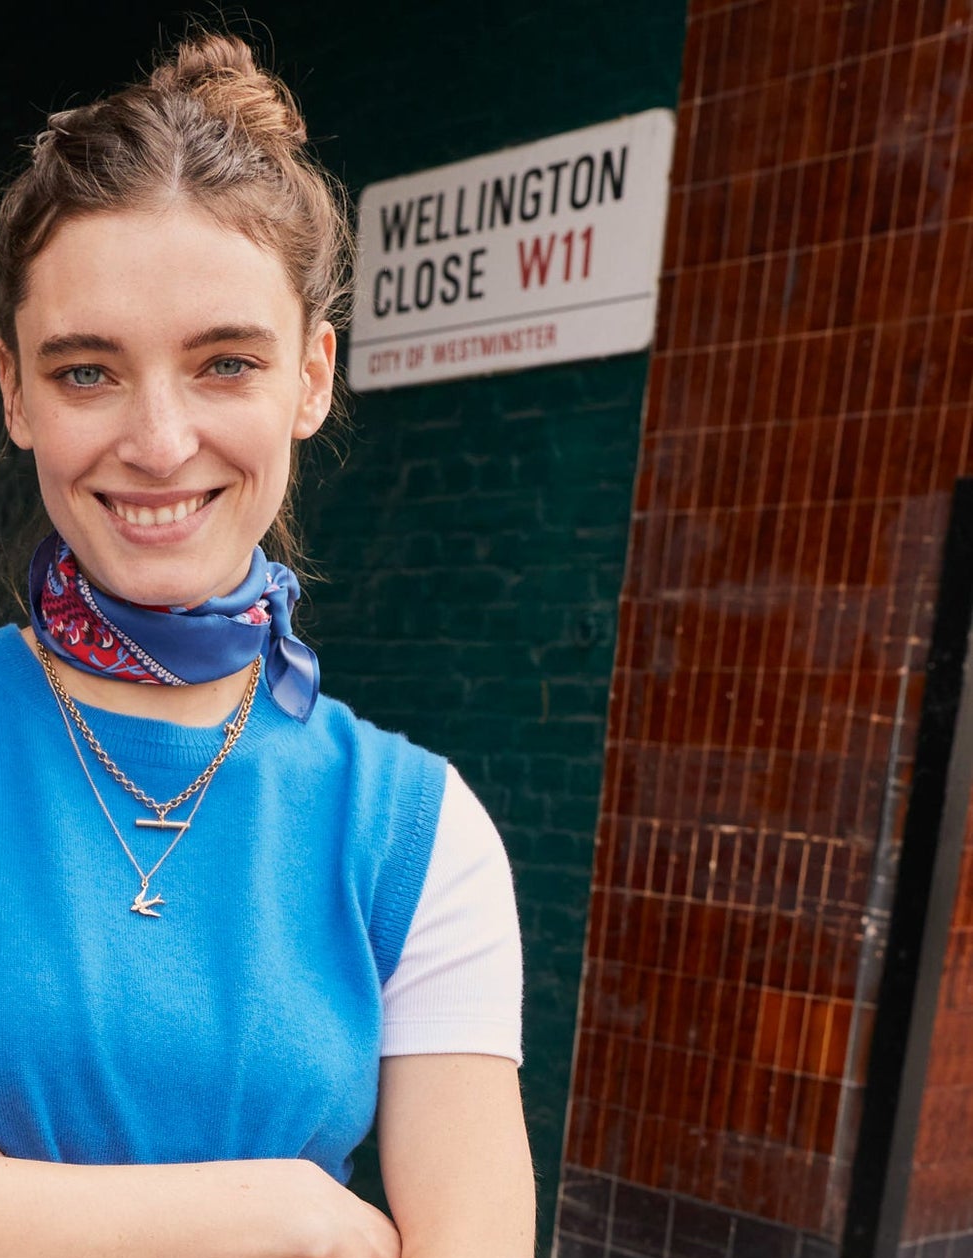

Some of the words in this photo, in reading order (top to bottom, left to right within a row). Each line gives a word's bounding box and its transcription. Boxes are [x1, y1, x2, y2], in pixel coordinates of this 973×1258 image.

[381, 146, 629, 254] WELLINGTON
[373, 248, 487, 319] CLOSE
[518, 224, 594, 290] W11
[368, 351, 401, 375] CITY
[405, 346, 426, 370] OF
[432, 323, 557, 364] WESTMINSTER
